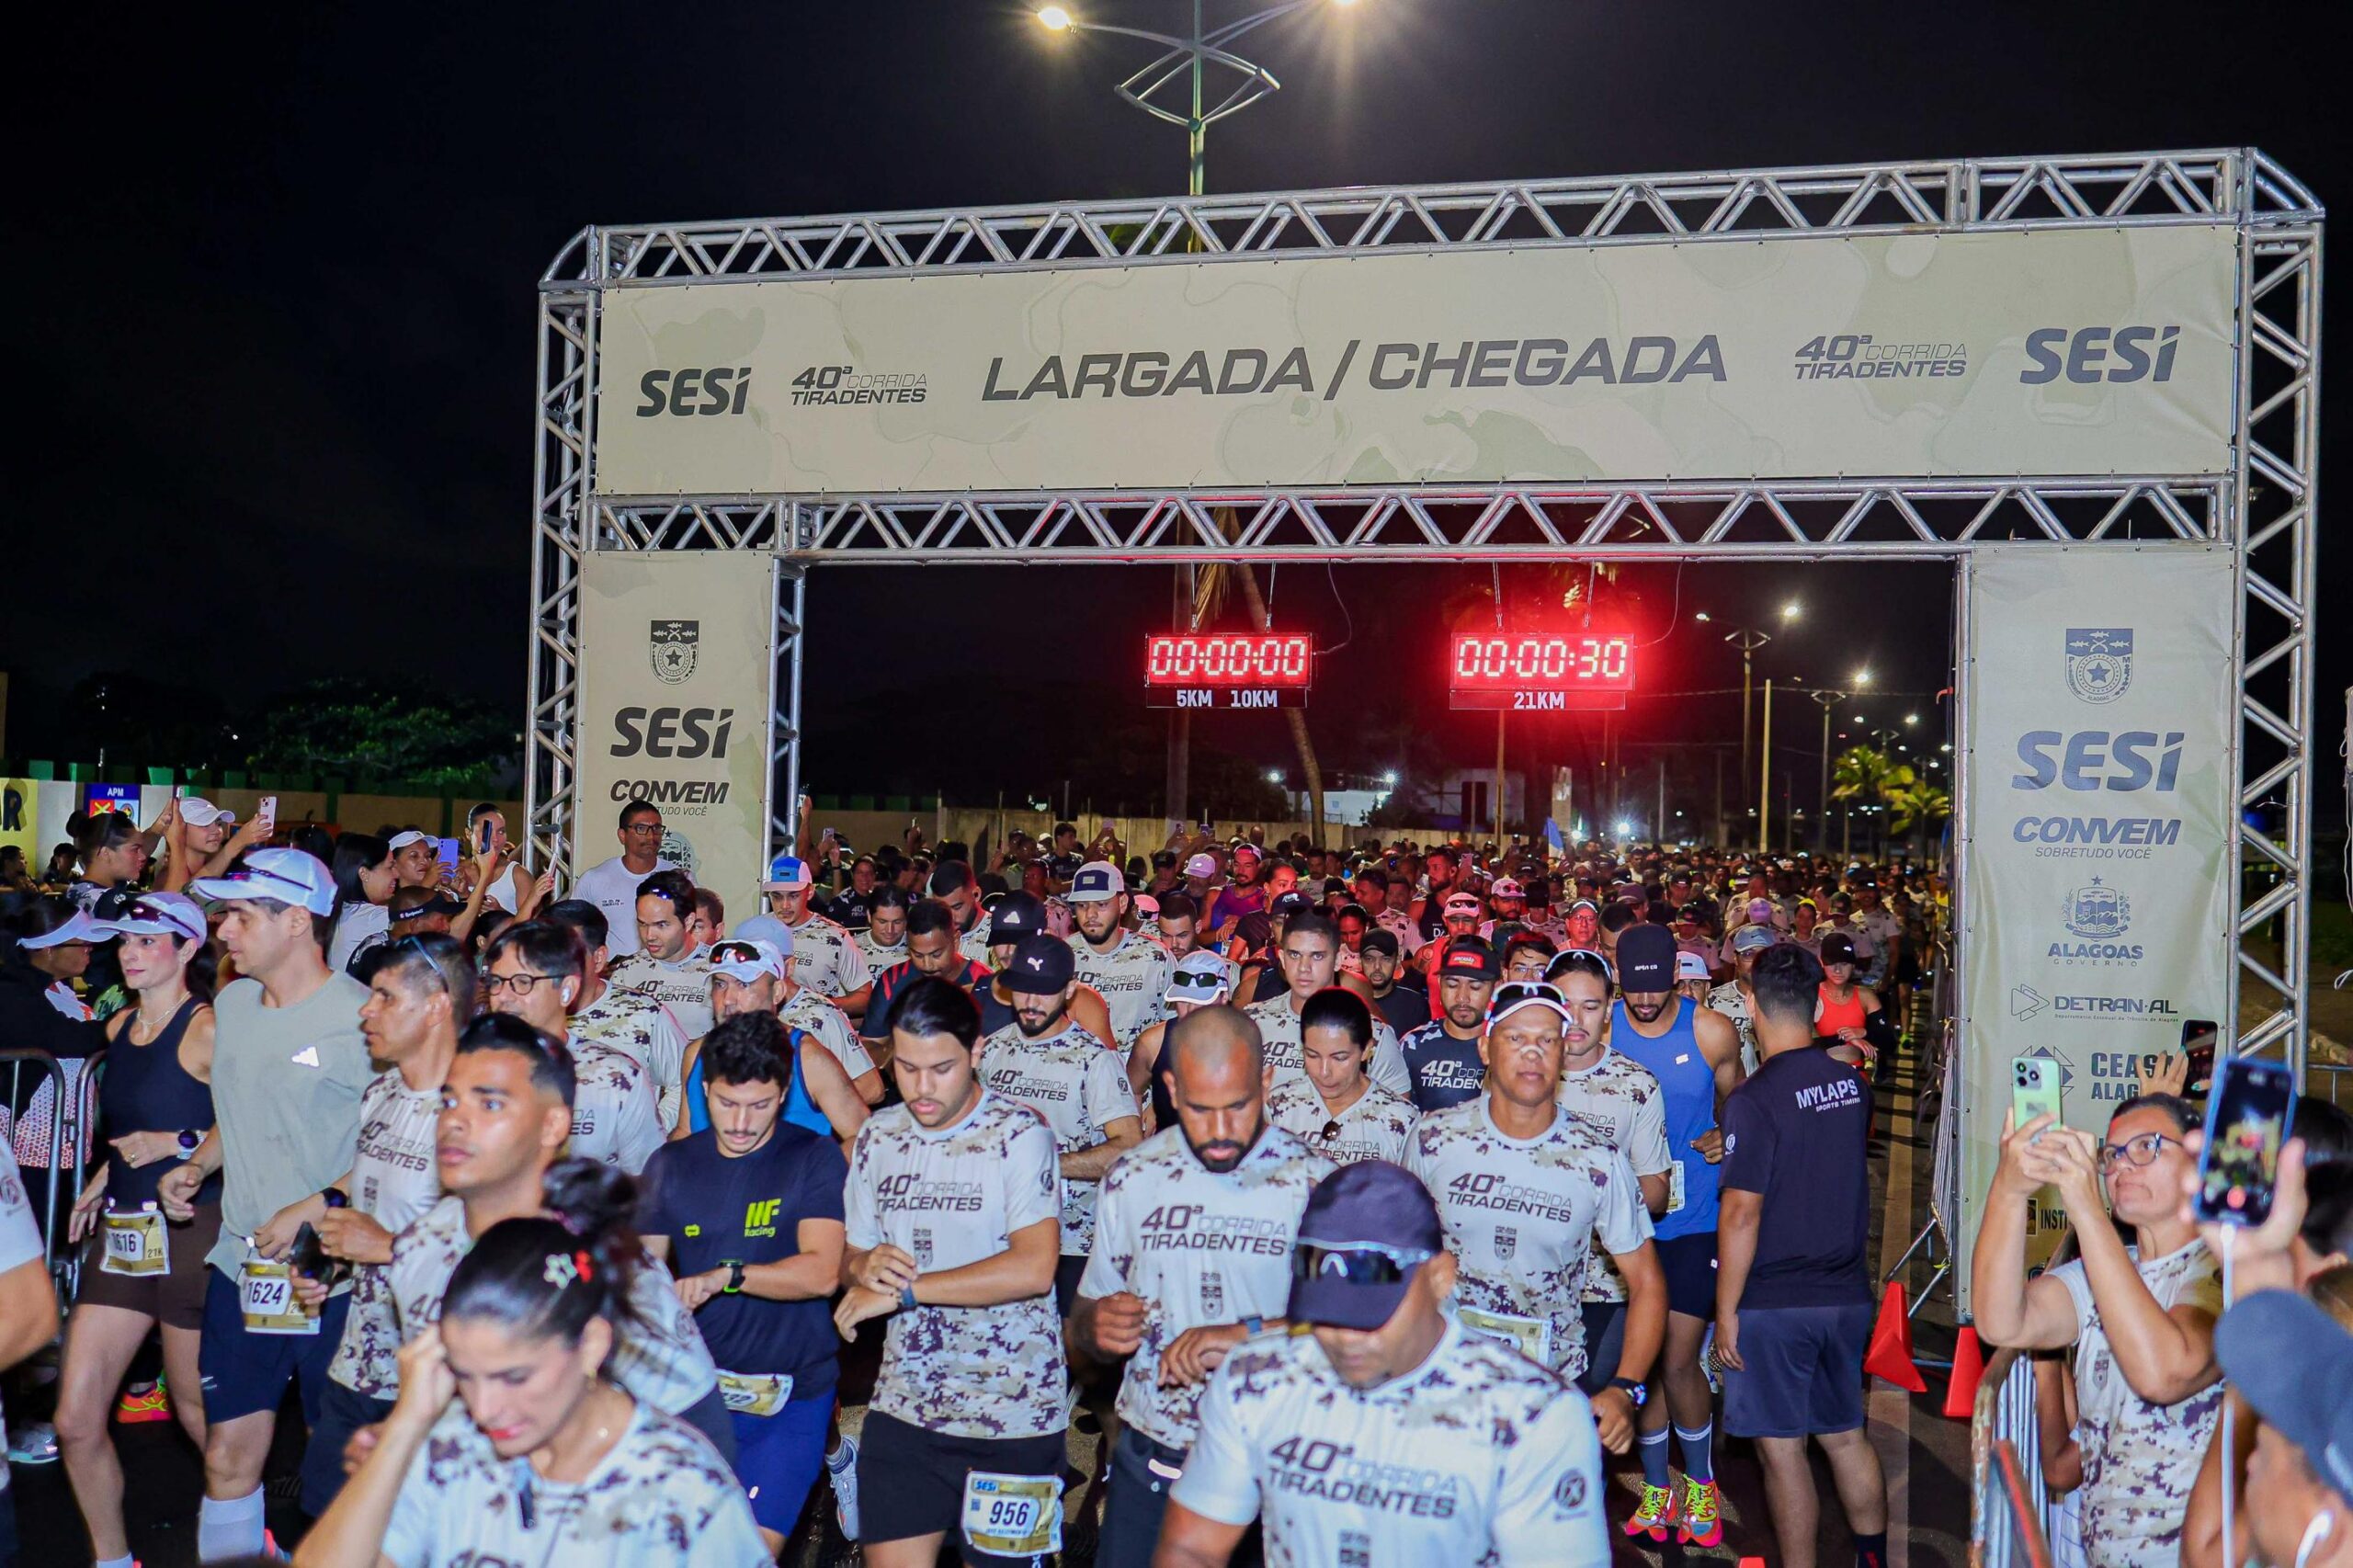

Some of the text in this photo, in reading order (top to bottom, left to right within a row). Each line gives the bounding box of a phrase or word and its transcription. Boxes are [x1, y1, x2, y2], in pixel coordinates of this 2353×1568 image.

[1864, 343, 1967, 360] CORRIDA
[981, 346, 1315, 402] LARGADA
[1370, 335, 1729, 391] CHEGADA
[1793, 358, 1967, 381] TIRADENTES
[847, 373, 927, 390] CORRIDA
[790, 388, 927, 406] TIRADENTES
[1151, 640, 1306, 677] 00:00:00
[1457, 640, 1628, 679] 00:00:30
[1176, 689, 1279, 709] 5KM 10KM
[1513, 691, 1565, 710] 21KM
[107, 787, 124, 797] APM
[609, 779, 731, 805] CONVEM
[683, 805, 709, 817] VOCÊ
[2013, 816, 2182, 846] CONVEM
[2035, 846, 2153, 859] SOBRETUDO VOCÊ
[2048, 942, 2143, 960] ALAGOAS
[2053, 959, 2138, 968] GOVERNO
[1094, 982, 1143, 993] DENTES
[1097, 973, 1143, 984] CORRIDA
[659, 984, 706, 994] CORRIDA
[1017, 1076, 1069, 1092] CORRIDA
[1420, 1076, 1484, 1090] TIRADEN
[2091, 1082, 2140, 1101] ALAG
[1795, 1078, 1859, 1109] MYLAPS
[1815, 1101, 1839, 1112] SPORTS
[1326, 1140, 1381, 1151] CORRIDA
[915, 1182, 983, 1196] CORRIDA
[1499, 1184, 1573, 1210] CORRIDA
[1448, 1191, 1573, 1224] TIRADENTES
[1197, 1215, 1288, 1237] CORRIDA
[2040, 1210, 2068, 1230] INSTI
[745, 1227, 777, 1238] Racing
[1140, 1233, 1288, 1256] TIRADENTES
[248, 1281, 286, 1305] 1624
[1268, 1466, 1457, 1519] TIRADENTES
[989, 1500, 1030, 1527] 956
